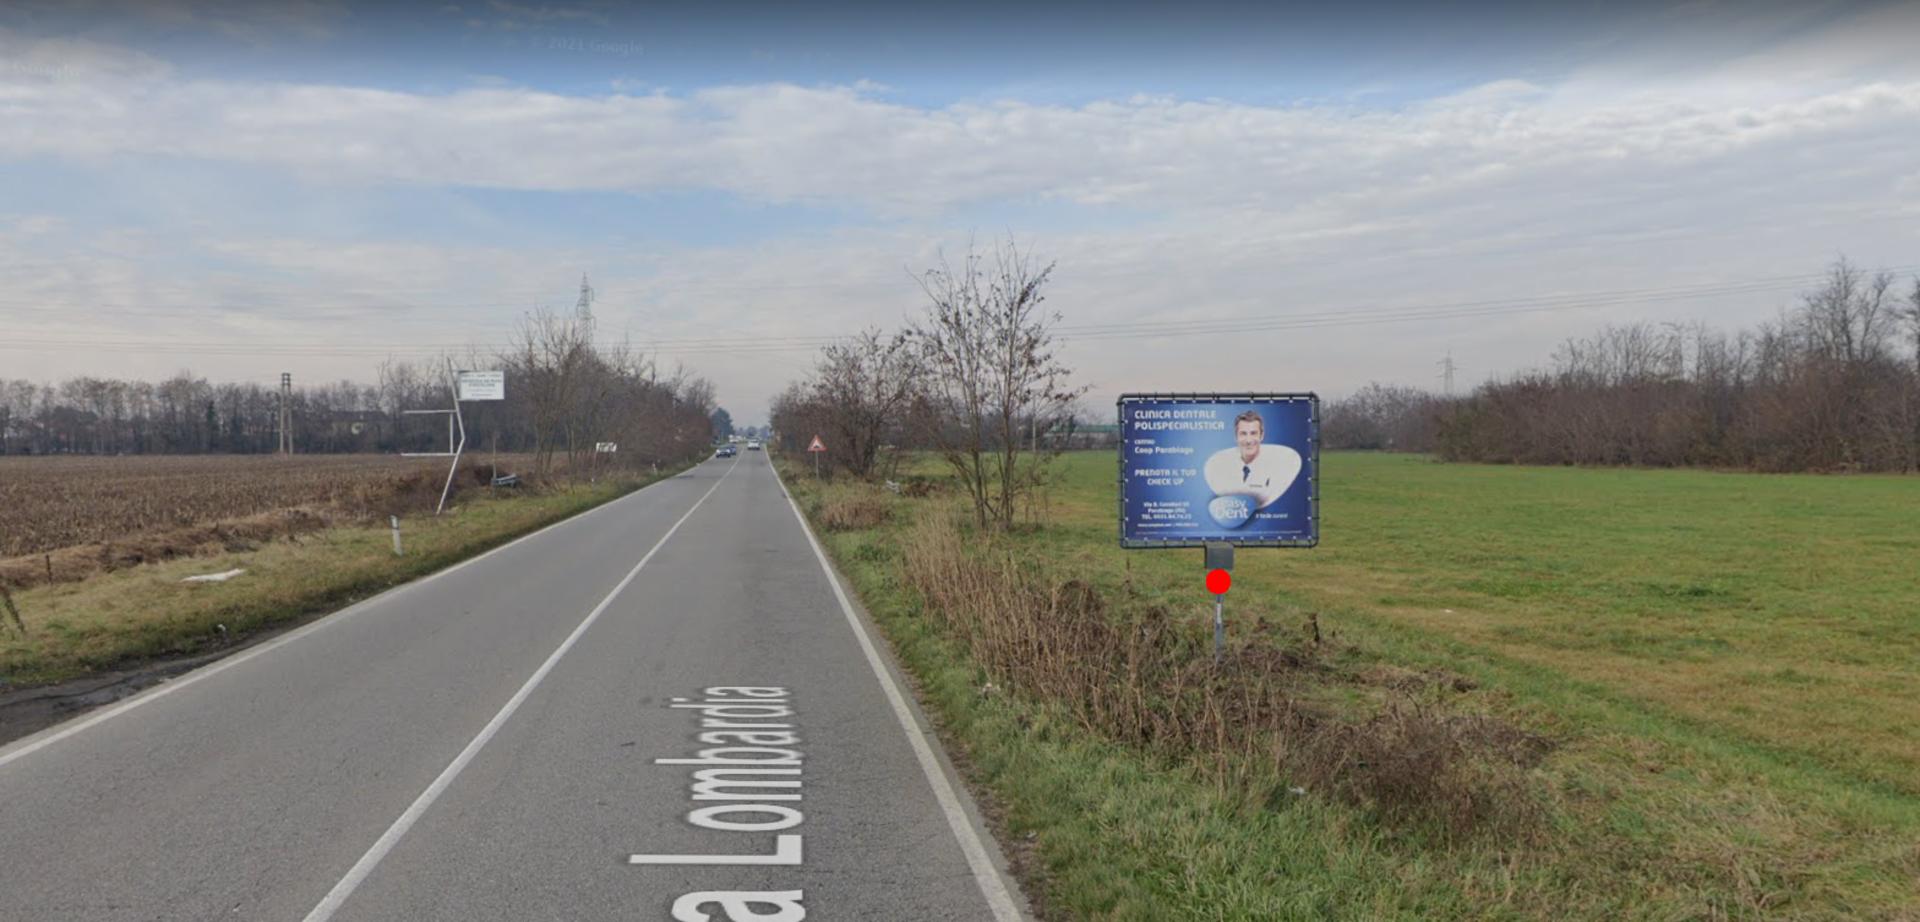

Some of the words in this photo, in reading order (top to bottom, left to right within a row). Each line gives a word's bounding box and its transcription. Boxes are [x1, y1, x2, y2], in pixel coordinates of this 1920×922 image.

[1134, 410, 1171, 419] CLINICA
[1173, 410, 1217, 418] DENTALE
[1134, 421, 1225, 430] POLISPECIALISTICA
[1134, 469, 1170, 477] PRENOTA
[1181, 469, 1197, 477] TUO
[1147, 478, 1171, 486] CHECK
[1173, 478, 1184, 486] UP
